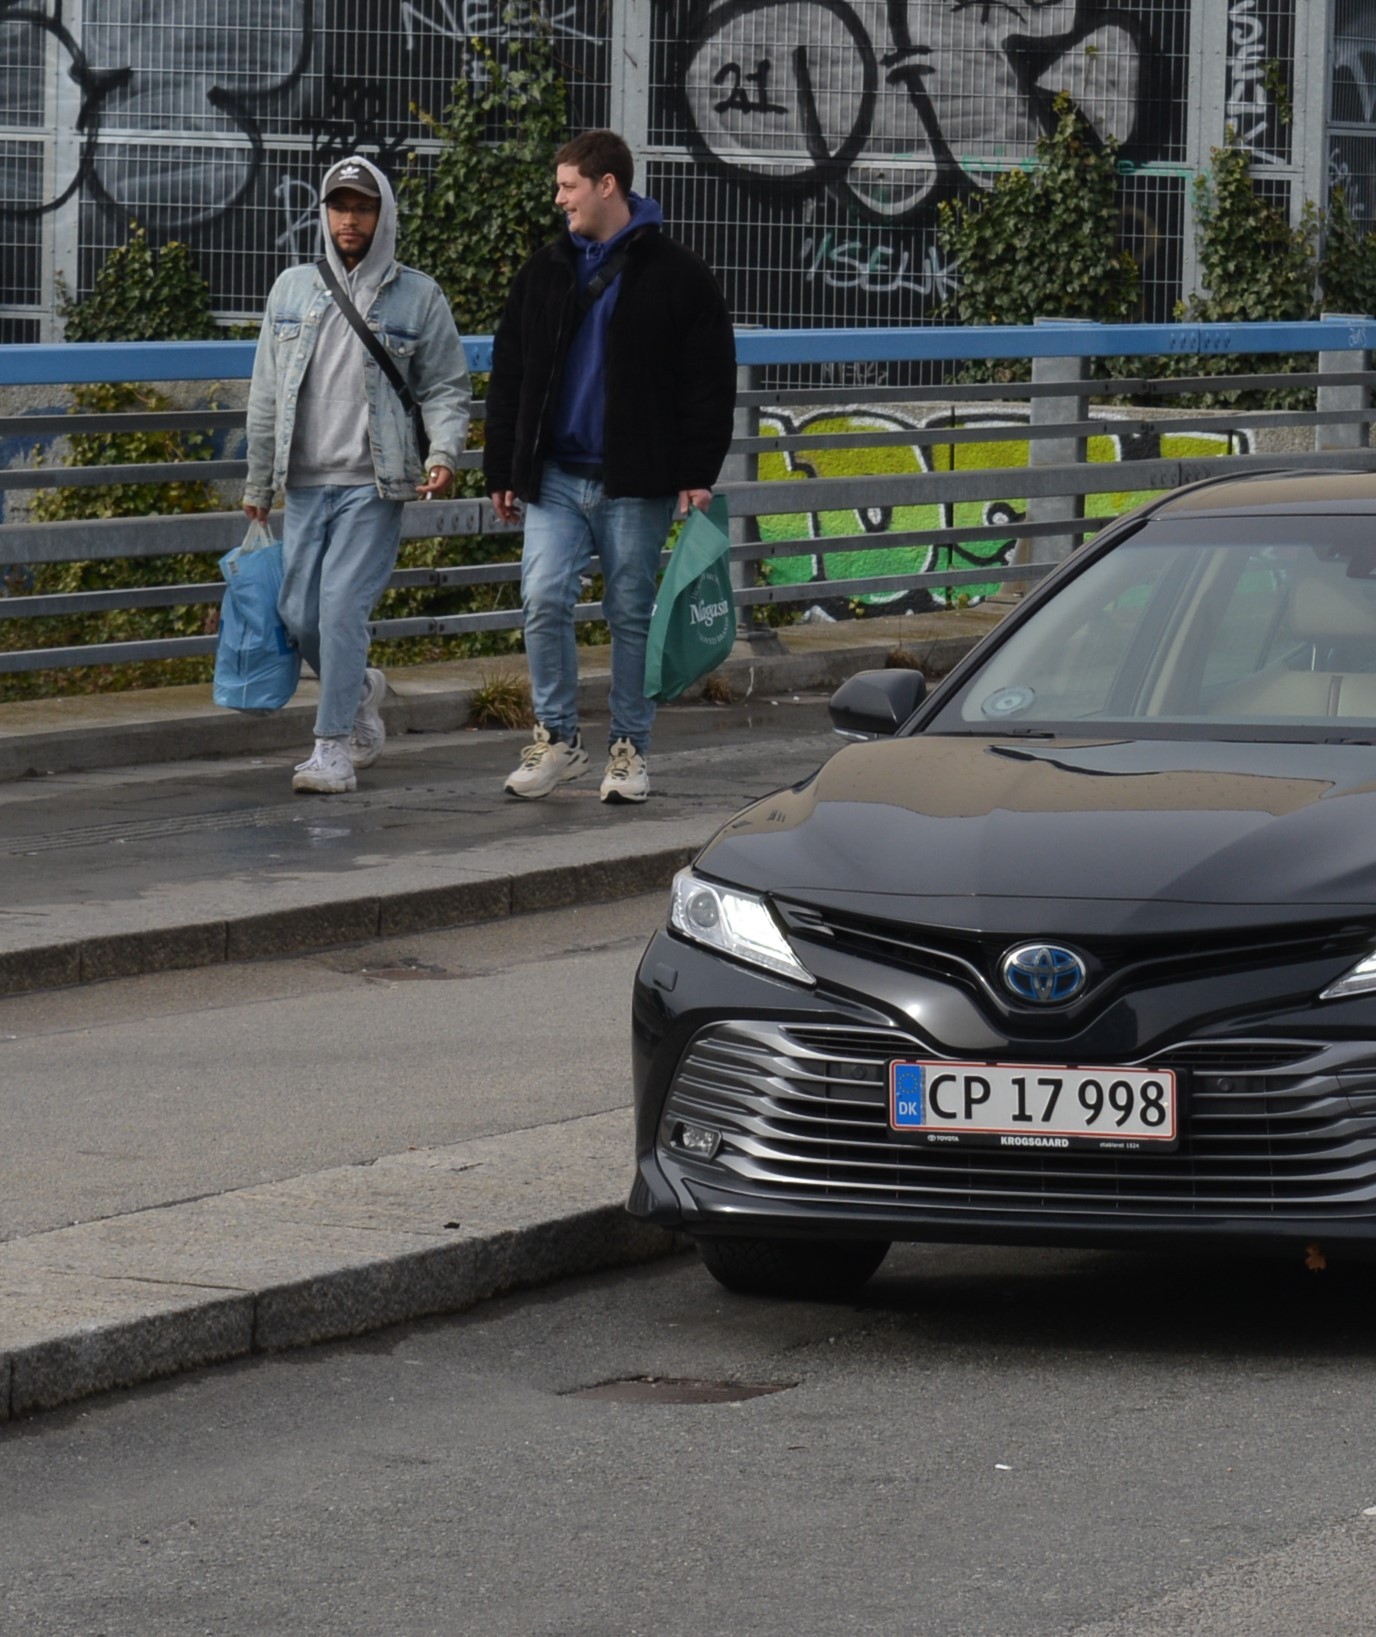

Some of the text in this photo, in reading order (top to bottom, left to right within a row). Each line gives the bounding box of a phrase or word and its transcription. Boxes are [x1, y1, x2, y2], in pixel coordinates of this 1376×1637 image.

[713, 58, 789, 114] 21
[928, 1073, 1167, 1128] CP 17 998
[898, 1101, 918, 1116] DK
[936, 1135, 960, 1143] TOYOTA
[1000, 1136, 1070, 1148] KROGSGAARD
